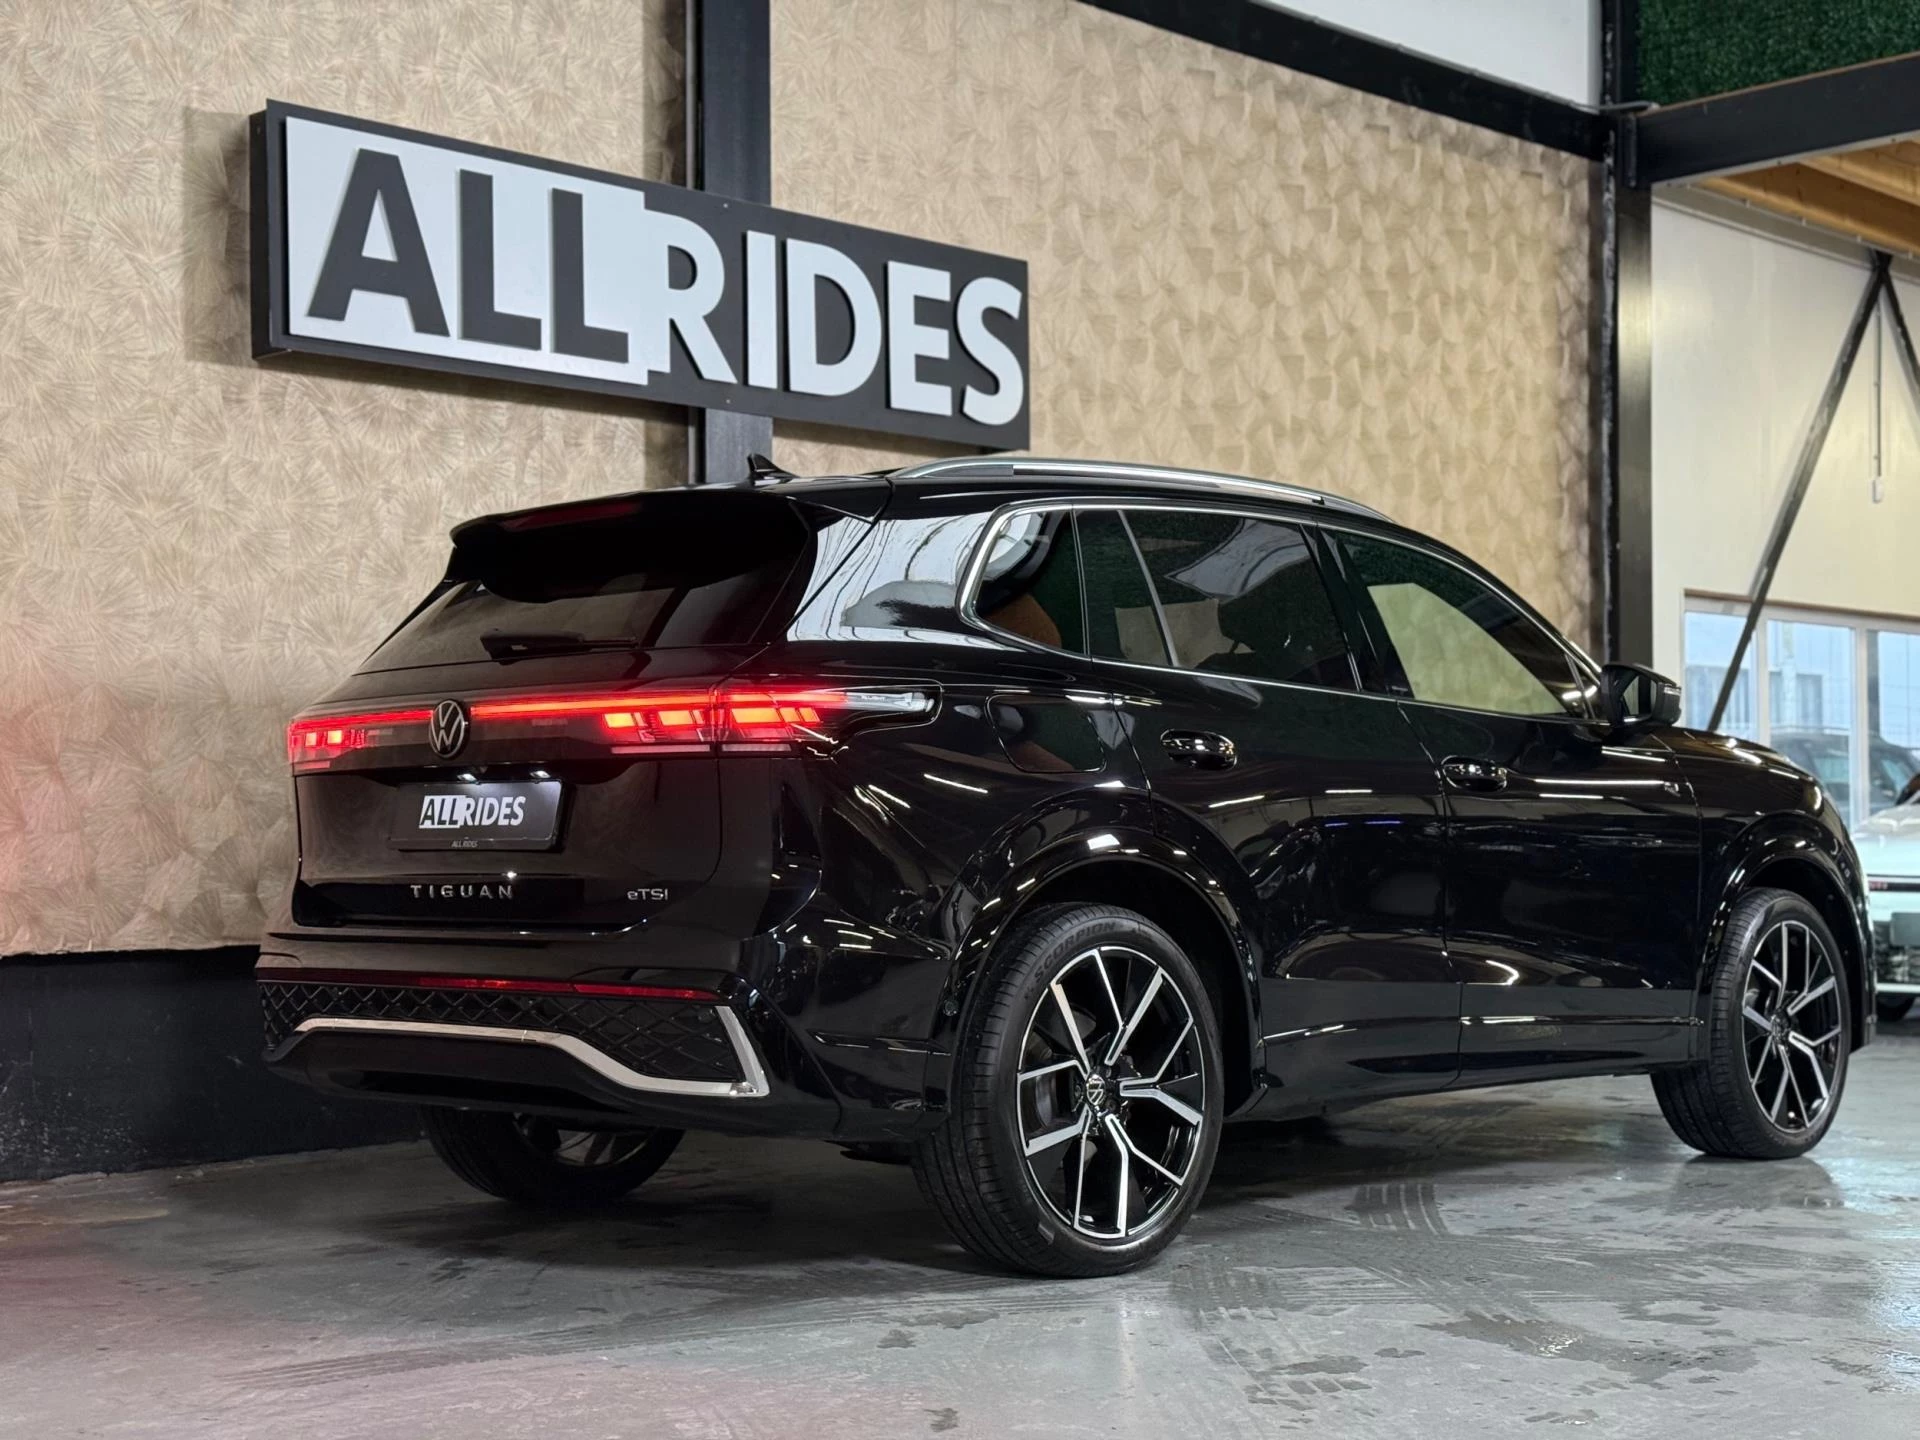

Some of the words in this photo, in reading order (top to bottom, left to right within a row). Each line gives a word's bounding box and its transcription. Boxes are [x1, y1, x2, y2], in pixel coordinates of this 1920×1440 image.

[410, 884, 513, 899] TIGUAN
[627, 888, 669, 900] eTSI
[1034, 921, 1116, 983] SCORPION
